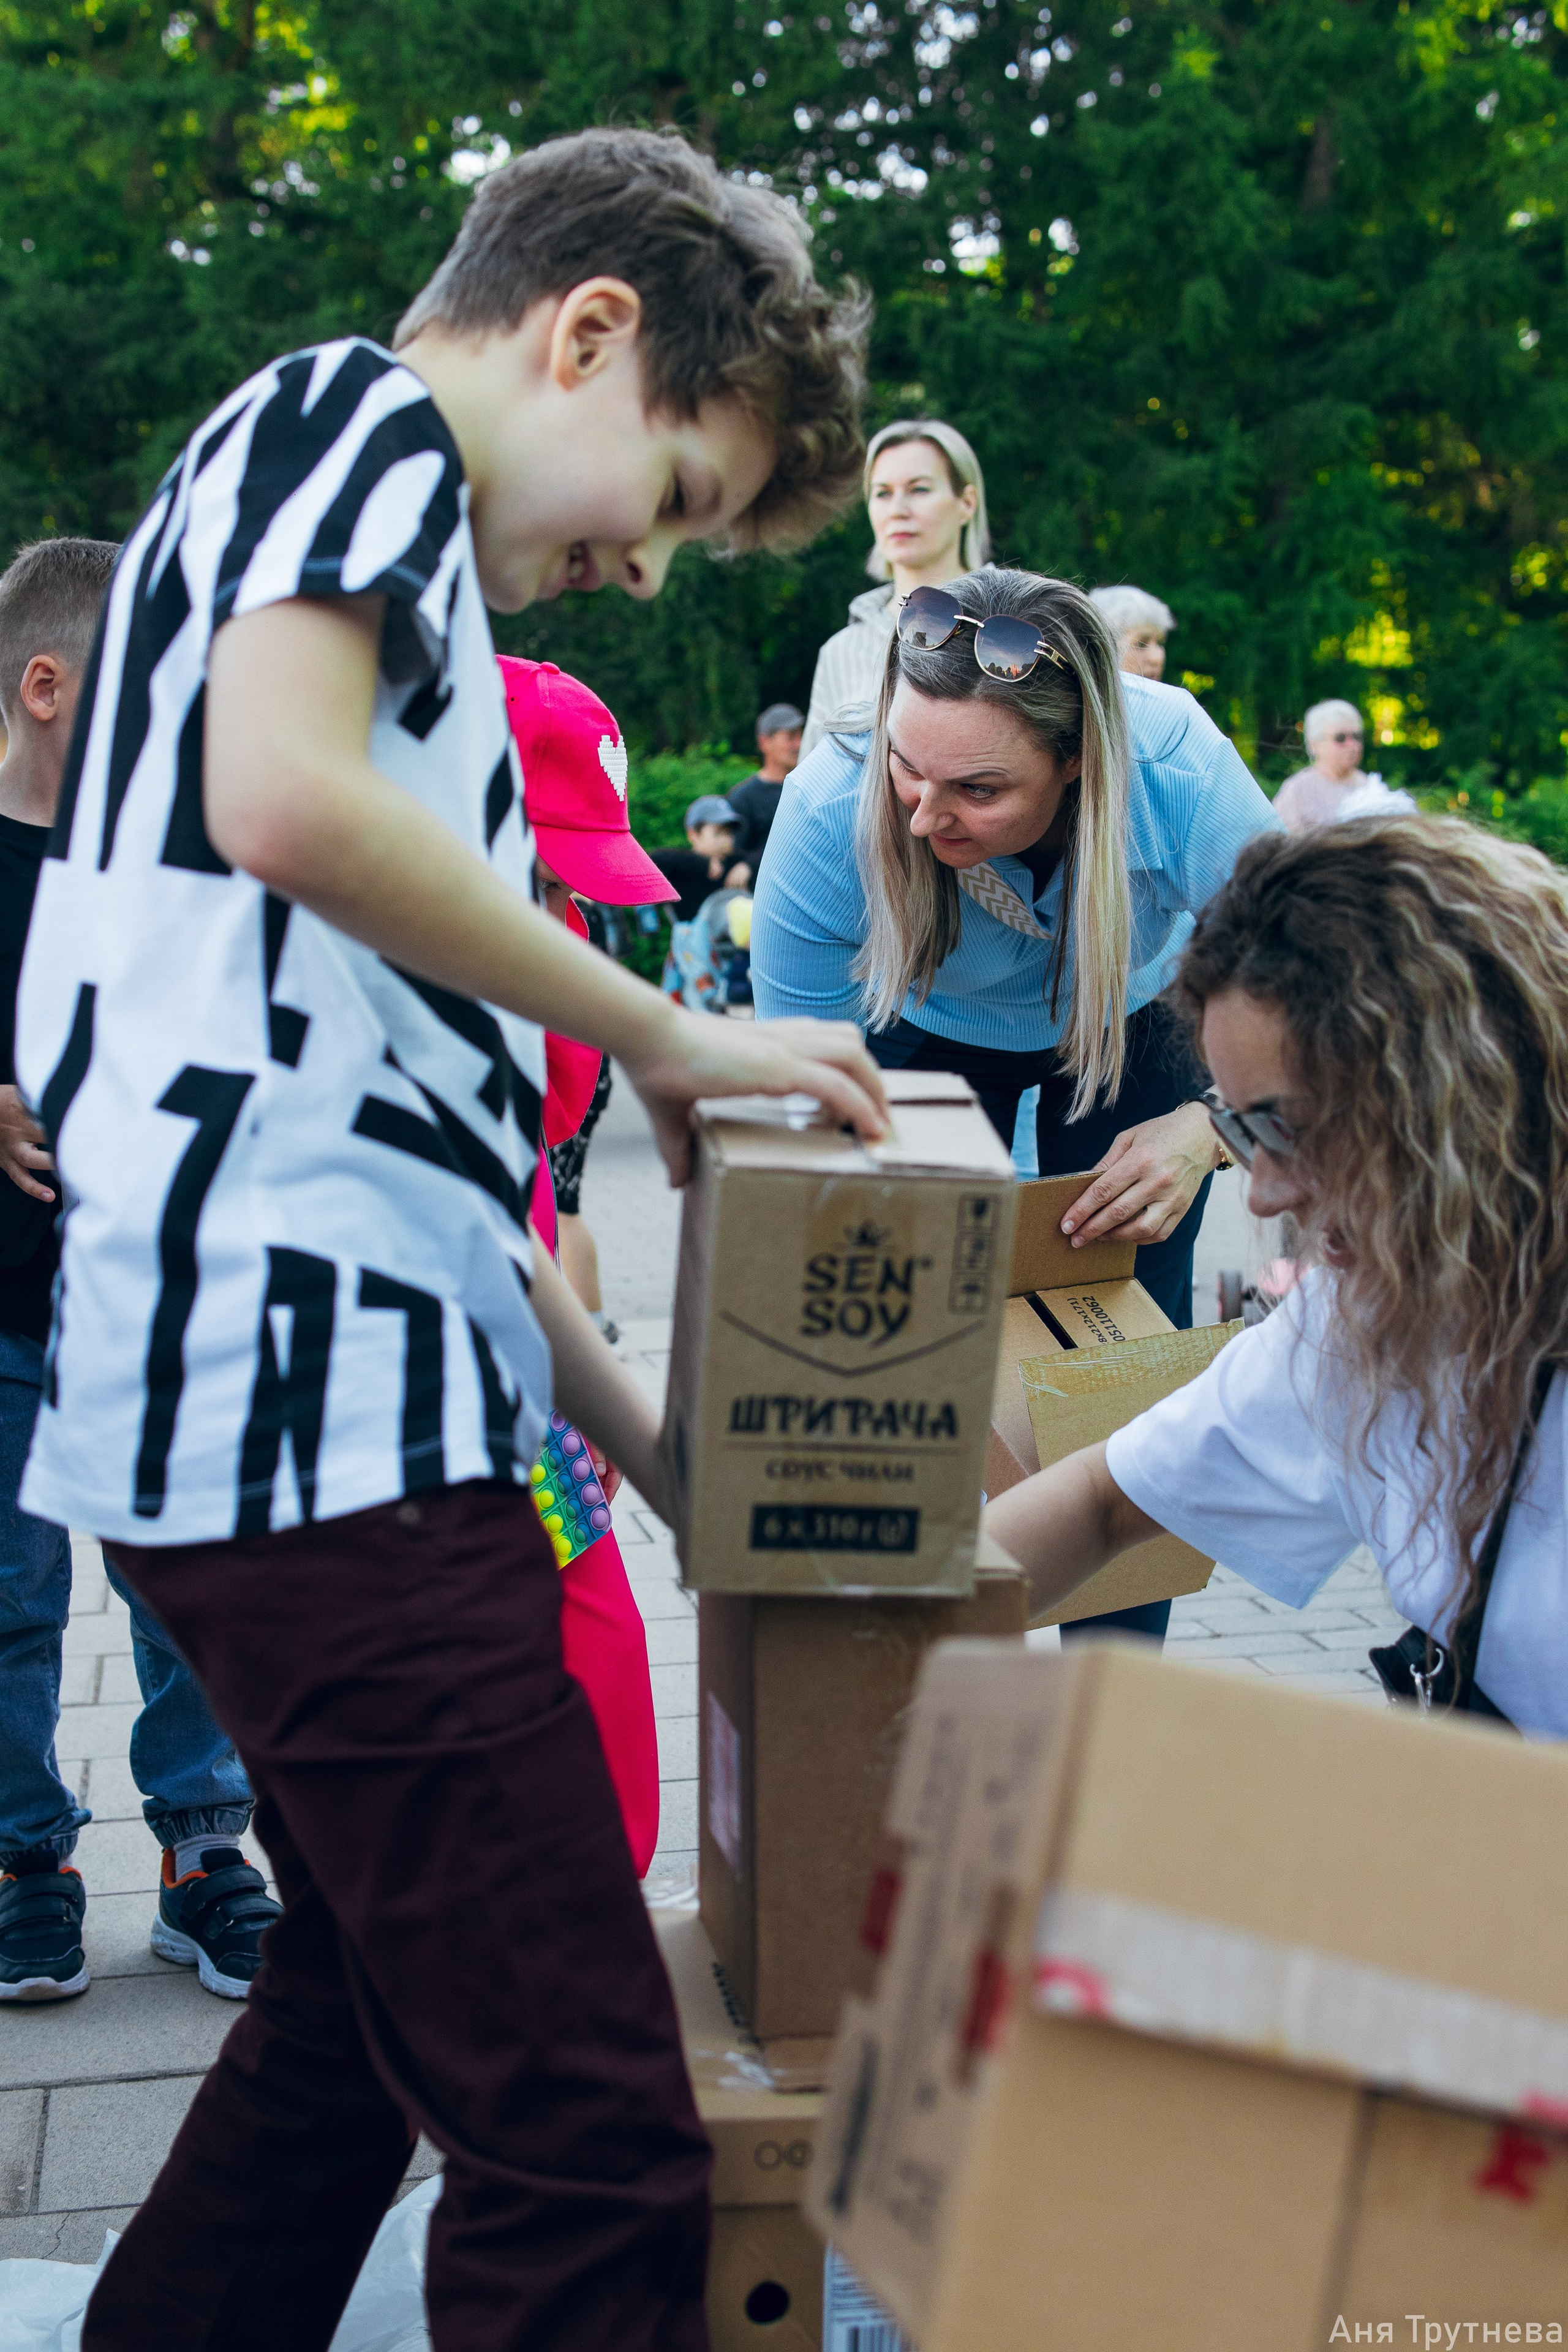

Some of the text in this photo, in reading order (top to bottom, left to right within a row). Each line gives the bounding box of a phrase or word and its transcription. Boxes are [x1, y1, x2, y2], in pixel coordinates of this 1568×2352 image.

[802, 1253, 914, 1295] SEN
[799, 1297, 911, 1348] SOY
[1066, 1297, 1109, 1345] 8x212x171)
[1082, 1295, 1126, 1341] 05110062
